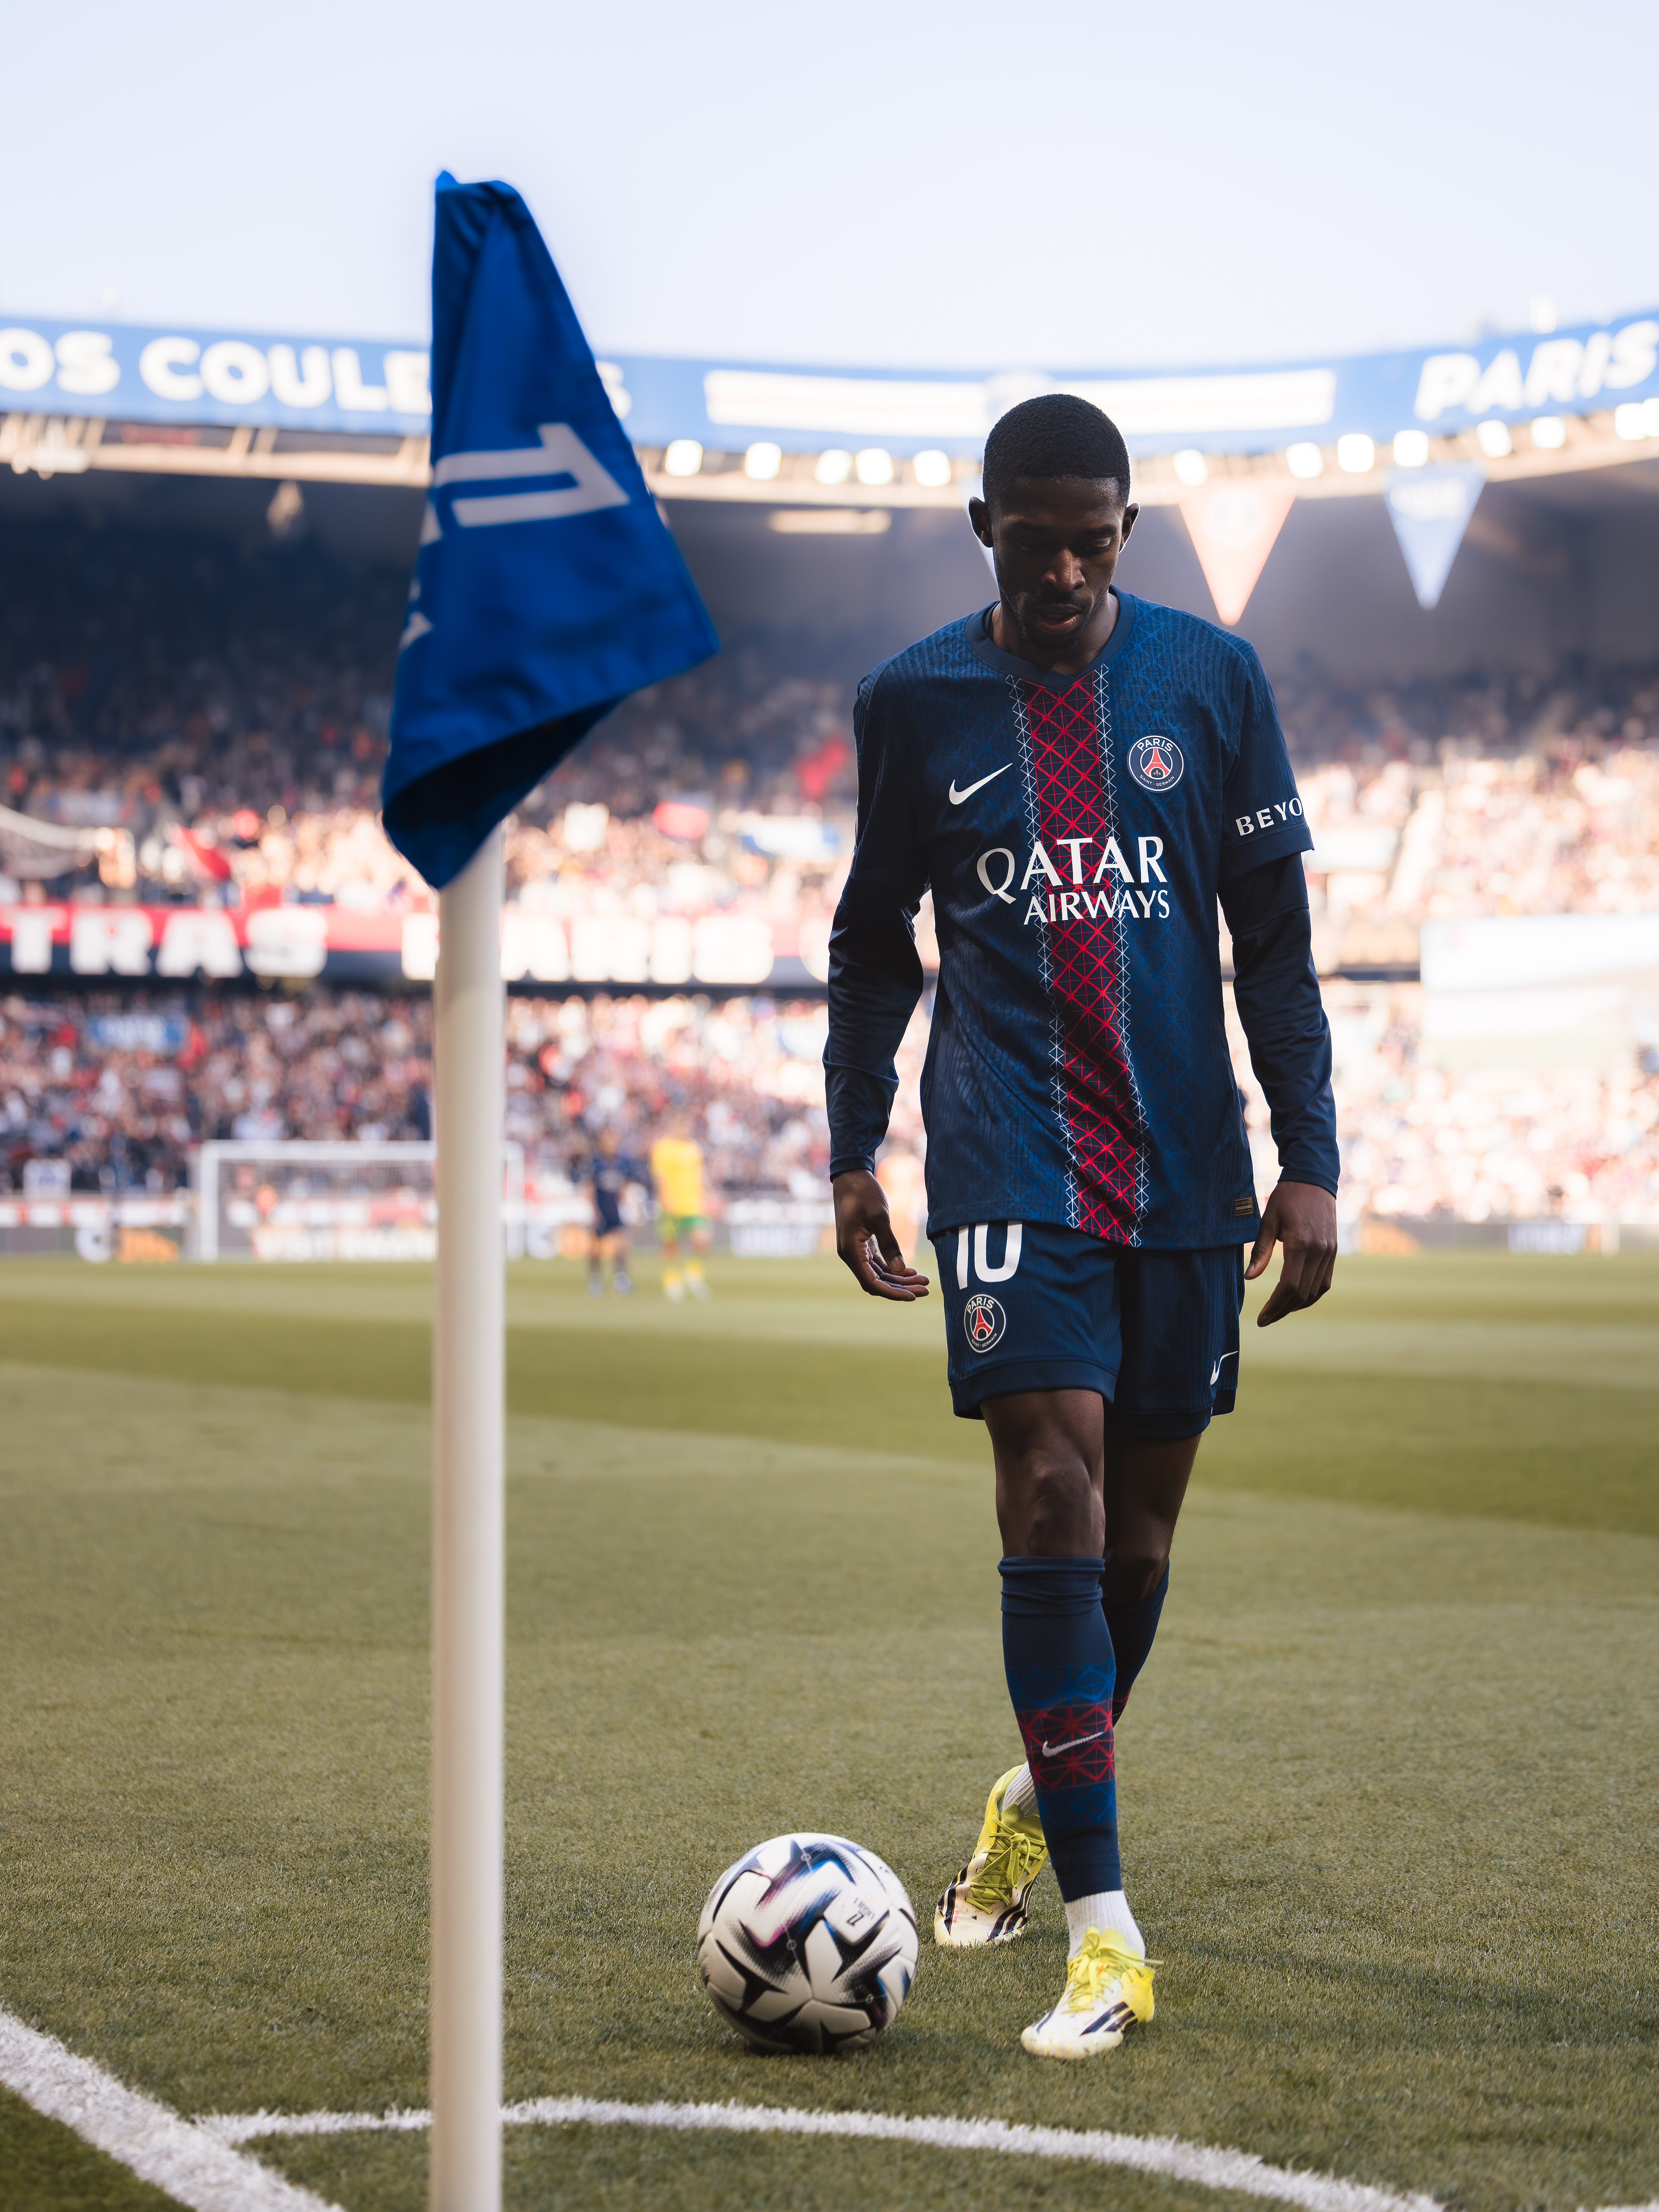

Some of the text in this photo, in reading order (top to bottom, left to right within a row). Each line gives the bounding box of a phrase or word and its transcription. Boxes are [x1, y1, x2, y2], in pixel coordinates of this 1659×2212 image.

[1413, 320, 1659, 421] PARIS
[1137, 738, 1173, 752] PARIS
[1235, 798, 1303, 836] BEYO
[976, 836, 1168, 904] QATAR
[1023, 890, 1170, 925] AIRWAYS
[957, 1220, 1023, 1290] 10
[967, 1297, 995, 1314] PARIS
